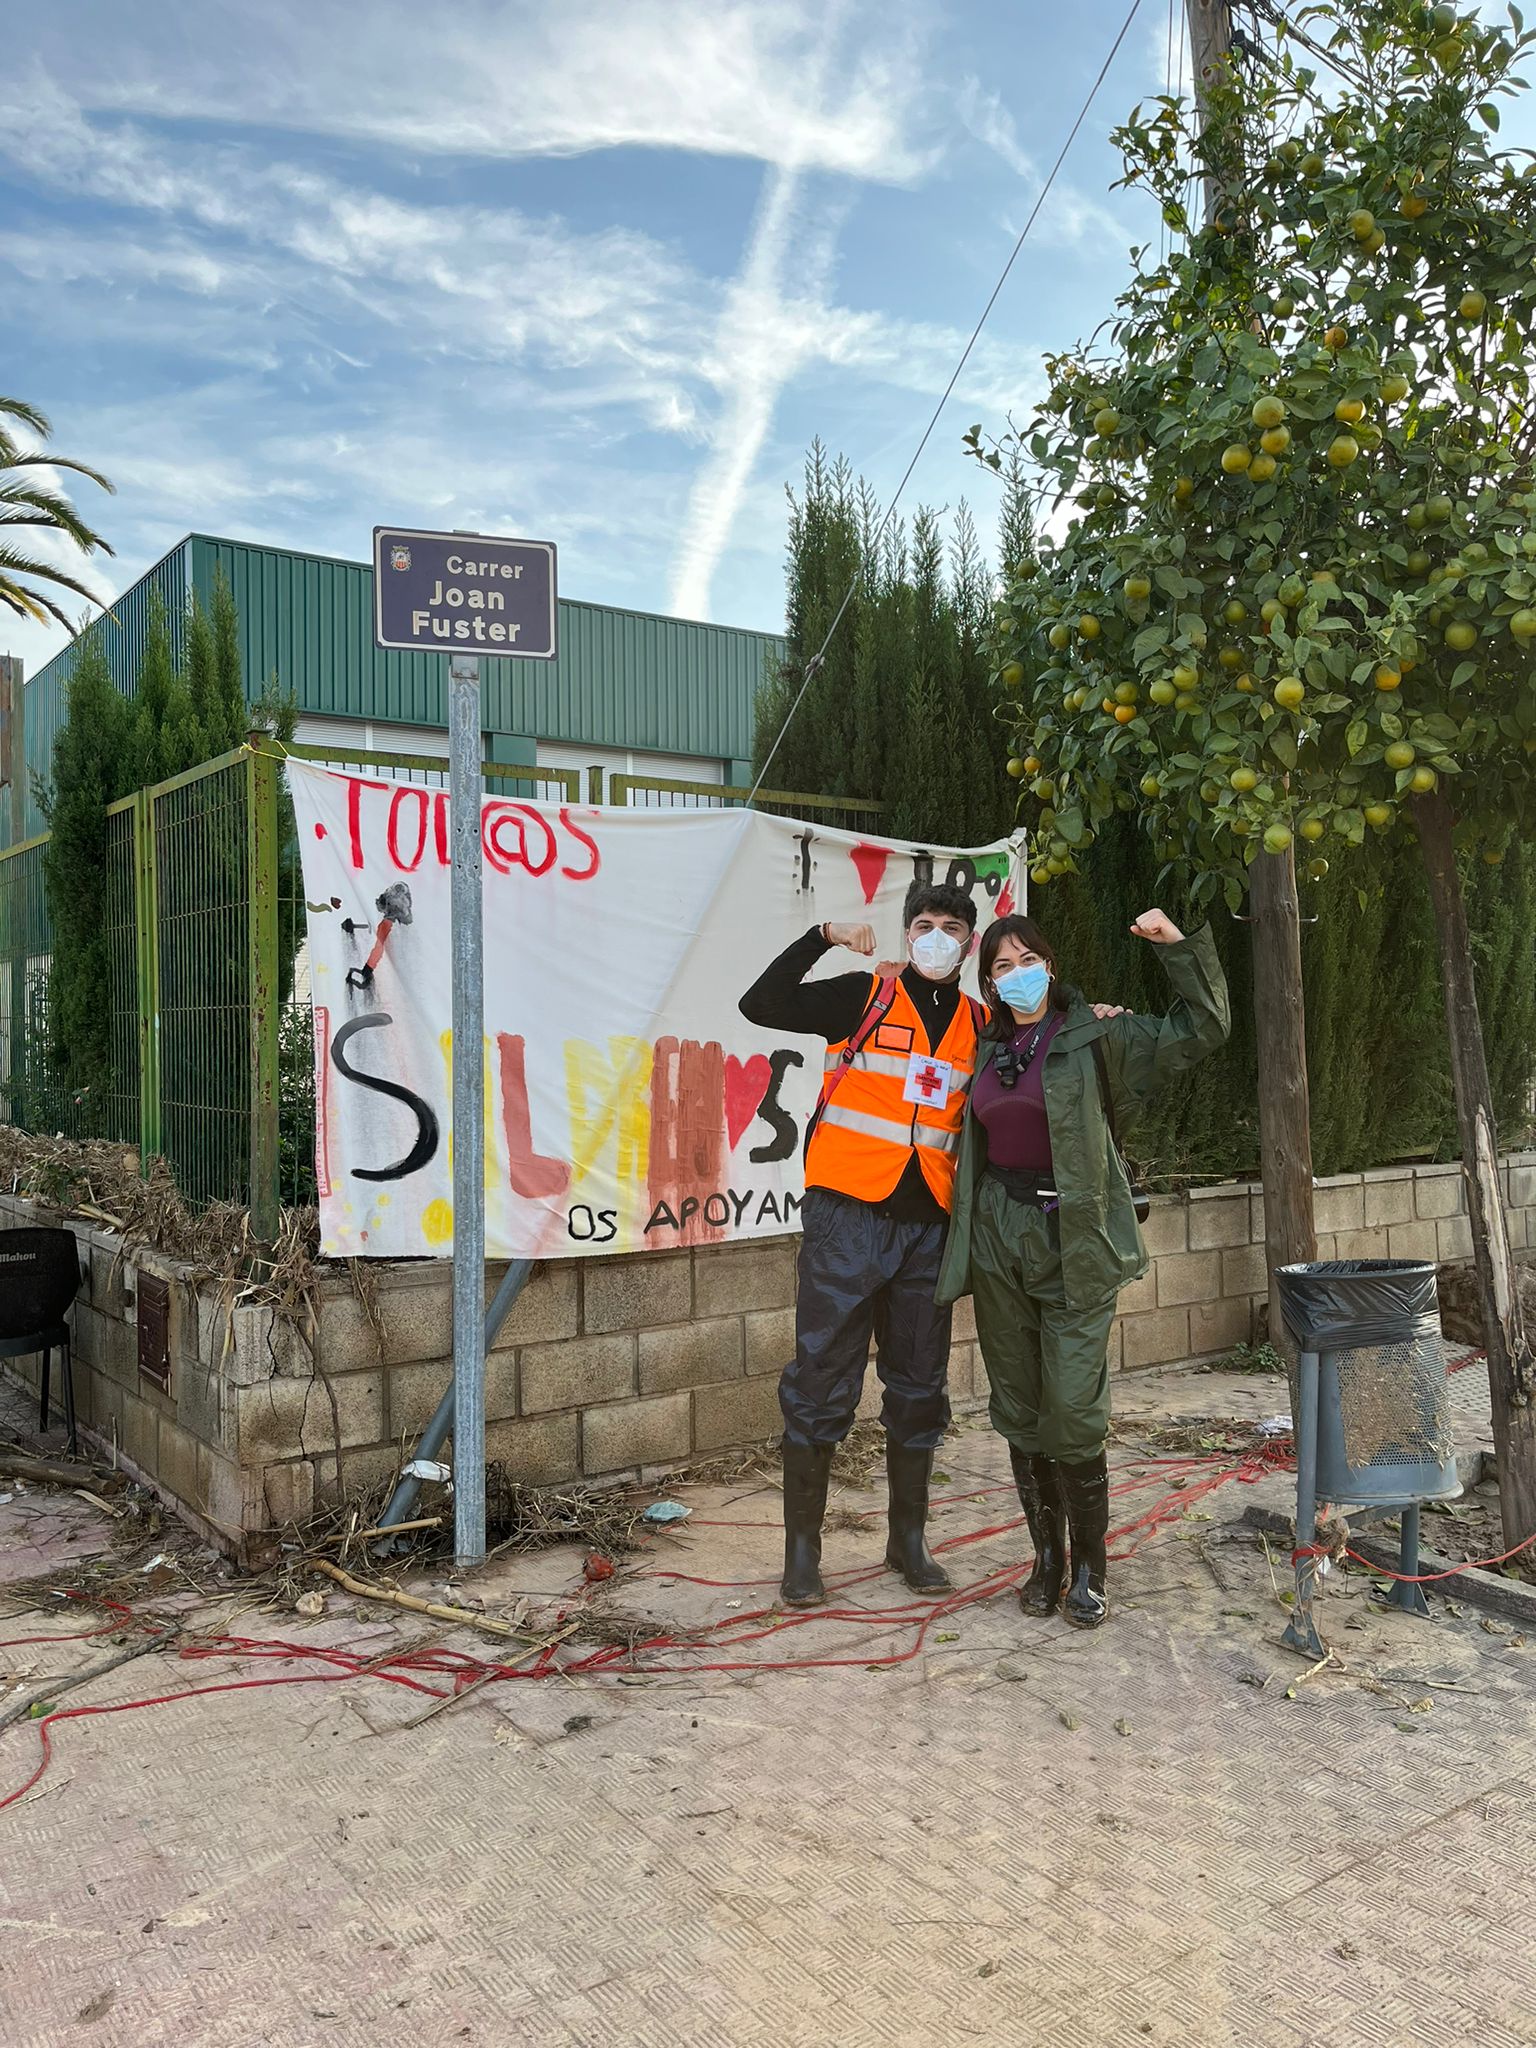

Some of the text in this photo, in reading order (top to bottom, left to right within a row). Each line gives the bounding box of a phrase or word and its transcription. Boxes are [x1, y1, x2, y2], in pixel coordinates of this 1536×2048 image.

[446, 555, 523, 579] Carrer
[429, 580, 505, 610] Joan
[412, 610, 521, 642] Fuster
[568, 1204, 617, 1242] OS
